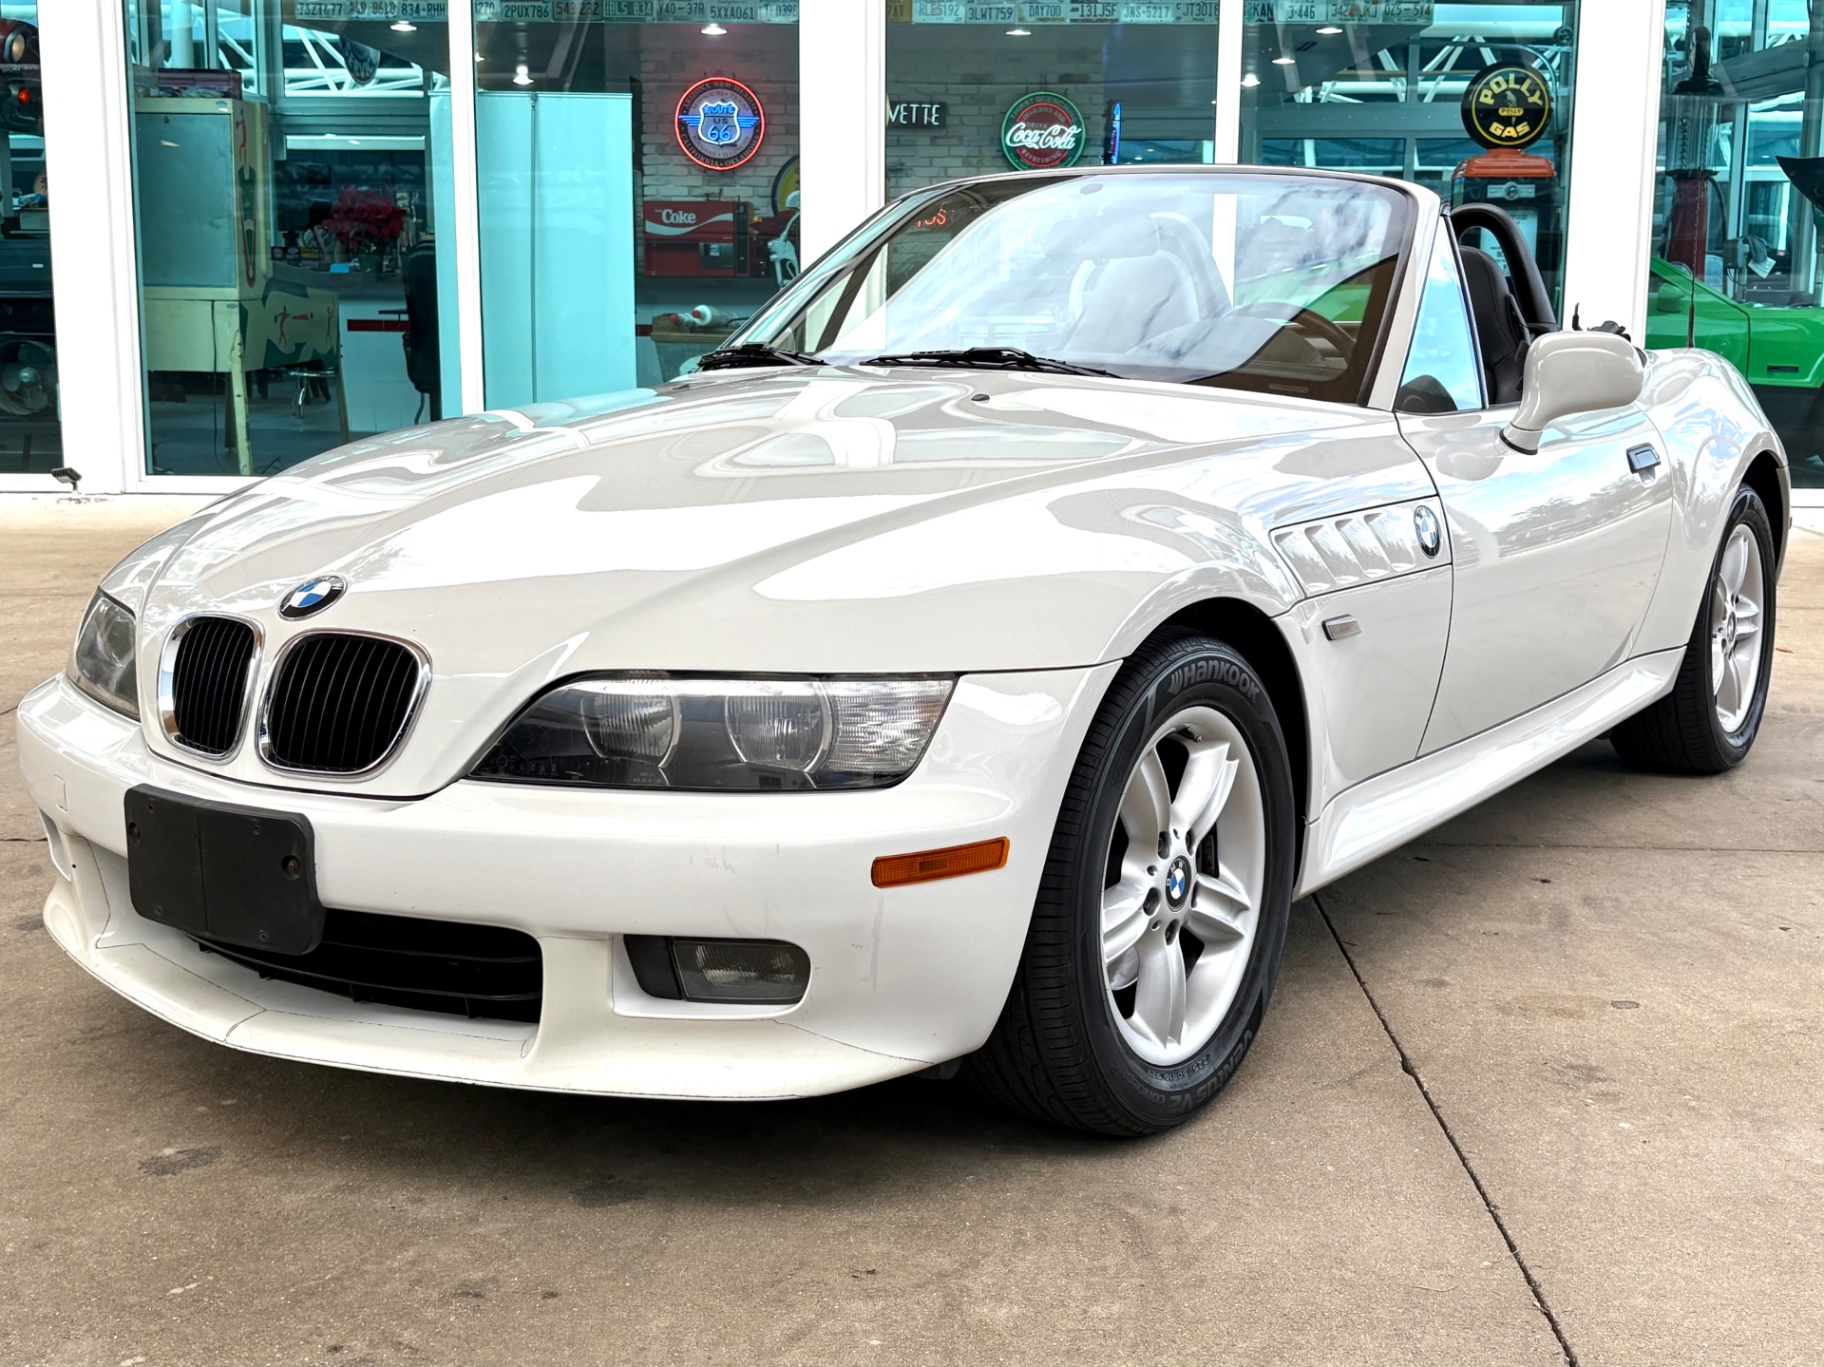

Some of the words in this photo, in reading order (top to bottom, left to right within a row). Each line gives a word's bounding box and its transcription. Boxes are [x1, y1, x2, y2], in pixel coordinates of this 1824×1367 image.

[504, 4, 549, 18] 2PUX786
[710, 5, 755, 20] 5XXA061
[968, 6, 1014, 20] 3LWT759
[1028, 4, 1061, 18] DAY700
[1479, 73, 1543, 106] POLLY
[705, 105, 735, 114] ROUTE
[889, 103, 941, 126] VETTE
[707, 124, 731, 141] 66
[1005, 121, 1082, 150] Coca-Cola
[1488, 121, 1531, 138] GAS
[661, 208, 697, 224] Coke
